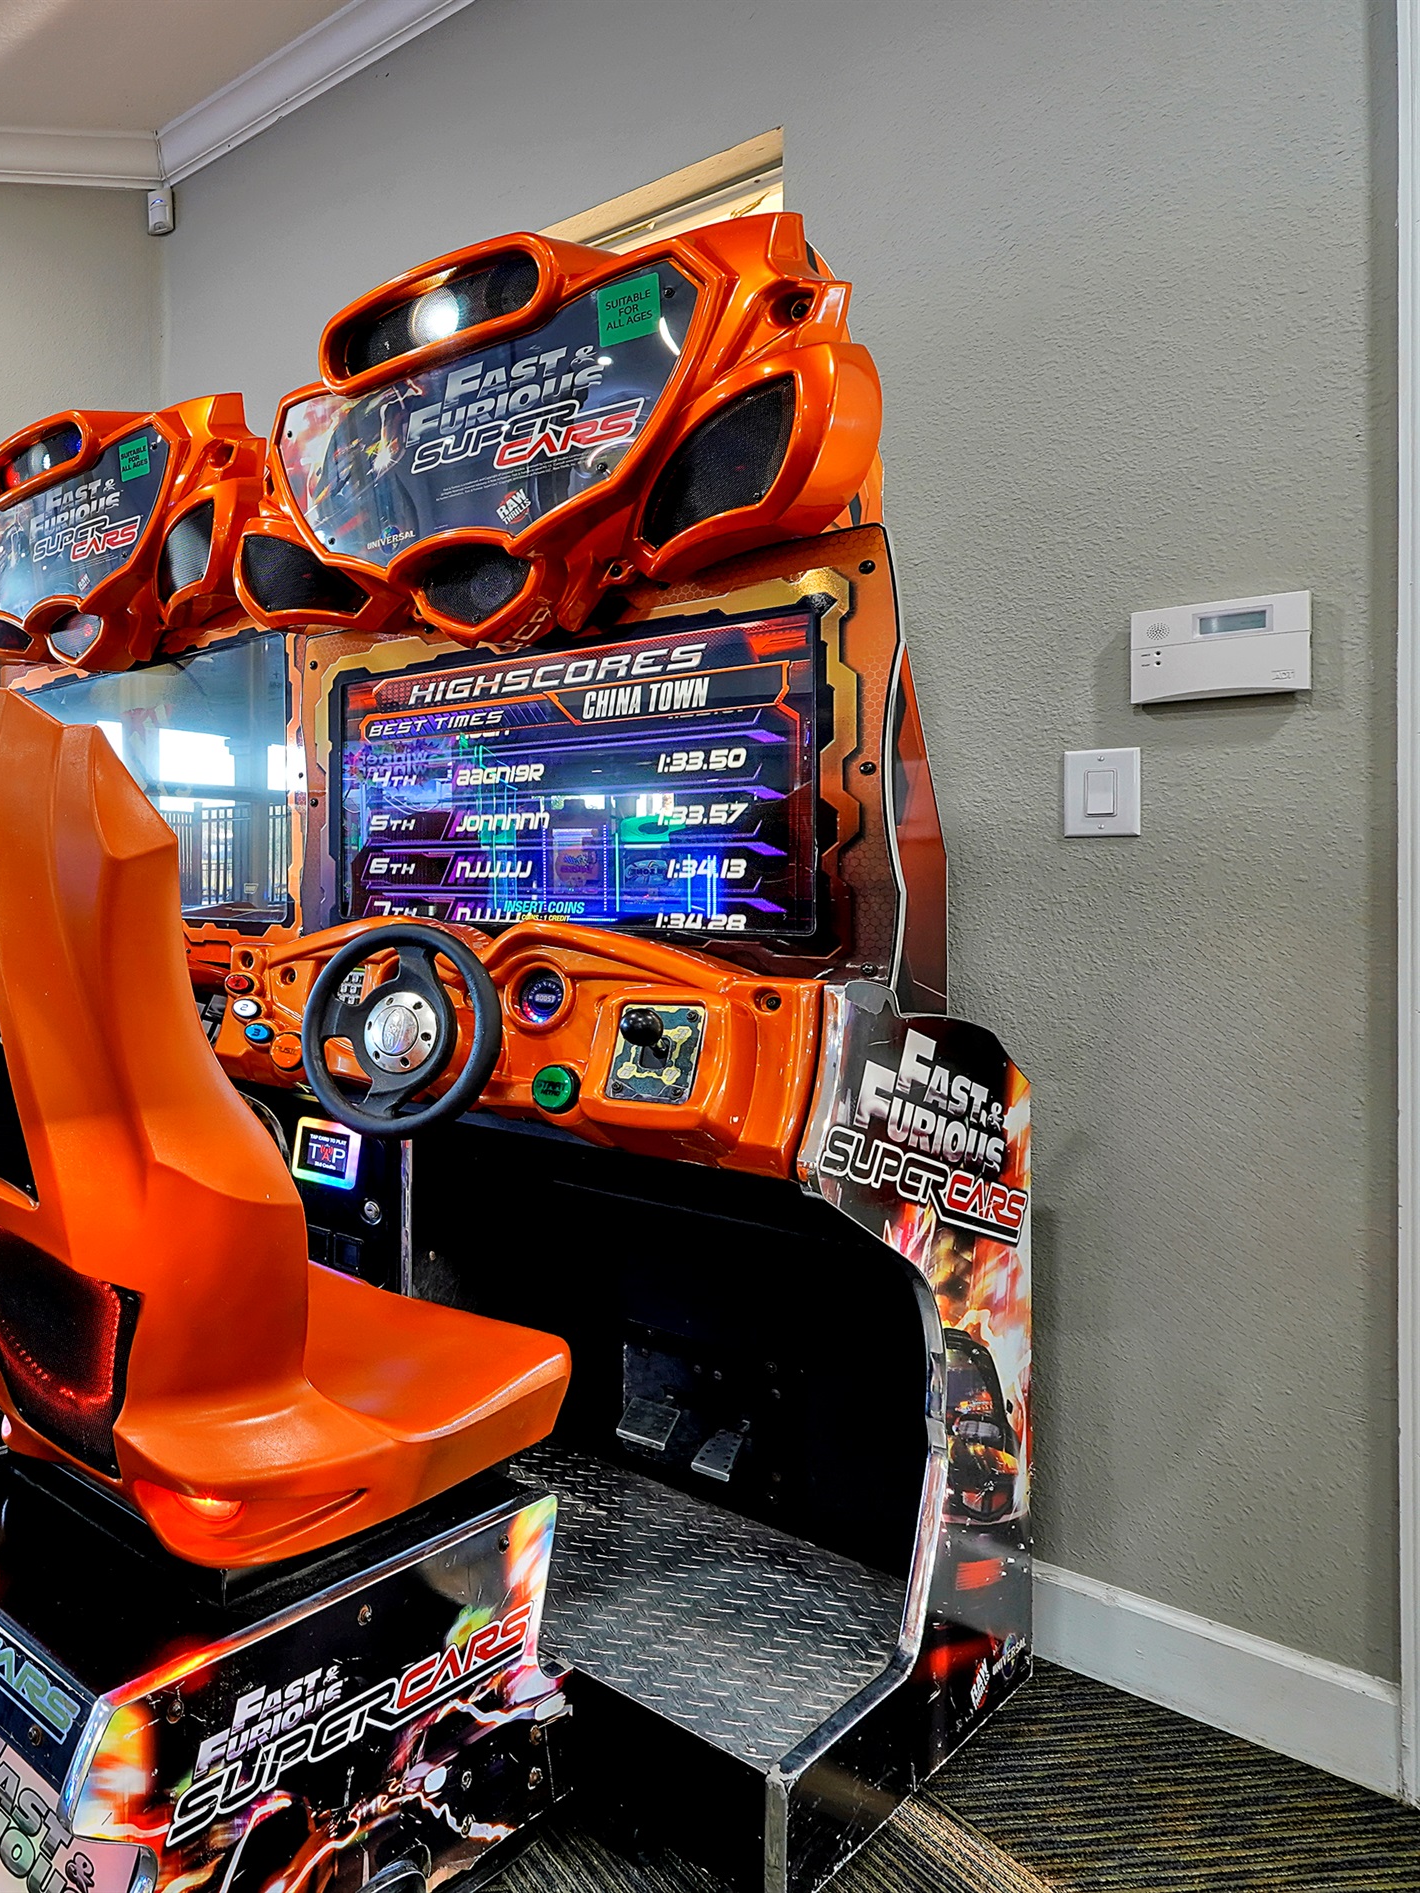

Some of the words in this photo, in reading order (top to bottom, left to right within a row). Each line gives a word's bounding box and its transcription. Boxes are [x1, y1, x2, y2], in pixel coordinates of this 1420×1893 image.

[605, 289, 651, 310] SUITABLE
[618, 303, 639, 317] FOR
[606, 320, 625, 331] ALL
[626, 310, 653, 325] AGES
[443, 346, 569, 410] FAST
[571, 345, 597, 365] &
[406, 364, 606, 448] FURIOUS
[411, 399, 581, 474] SUPER
[493, 406, 642, 471] CARS
[120, 445, 147, 460] SUITABLE
[128, 454, 140, 463] FOR
[122, 464, 132, 472] ALL
[132, 458, 148, 469] AGES
[45, 479, 102, 514] FAST
[103, 478, 116, 493] &
[496, 488, 528, 519] RAW
[29, 491, 121, 546] FURIOUS
[502, 497, 532, 526] THRILLS
[33, 515, 110, 563] SUPER
[70, 522, 140, 563] CARS
[367, 530, 416, 550] UNIVERSAL
[409, 642, 707, 705] HIGHSCORES
[582, 683, 641, 720] CHINA
[648, 676, 711, 712] TOWN
[368, 718, 425, 738] BEST
[433, 710, 505, 731] TIMES
[657, 748, 748, 773] 1:33.50
[371, 770, 417, 787] 4TH
[369, 814, 416, 831] 5TH
[657, 802, 749, 826] 1:33.57
[369, 857, 416, 875] 6TH
[666, 858, 748, 879] 1:34.13
[373, 900, 418, 917] 7TH
[503, 900, 545, 913] INSERT
[547, 901, 586, 914] COINS
[548, 914, 570, 922] CREDIT
[655, 913, 748, 931] 1:34.28
[239, 1003, 249, 1012] 2
[535, 993, 556, 1004] BOOST
[252, 1028, 262, 1037] 3
[897, 1028, 989, 1124] FAST
[987, 1102, 1003, 1131] &
[853, 1060, 1007, 1174] FURIOUS
[308, 1142, 346, 1164] TAP
[231, 1667, 323, 1737] FAST
[324, 1665, 340, 1684] &
[194, 1679, 345, 1780] FURIOUS
